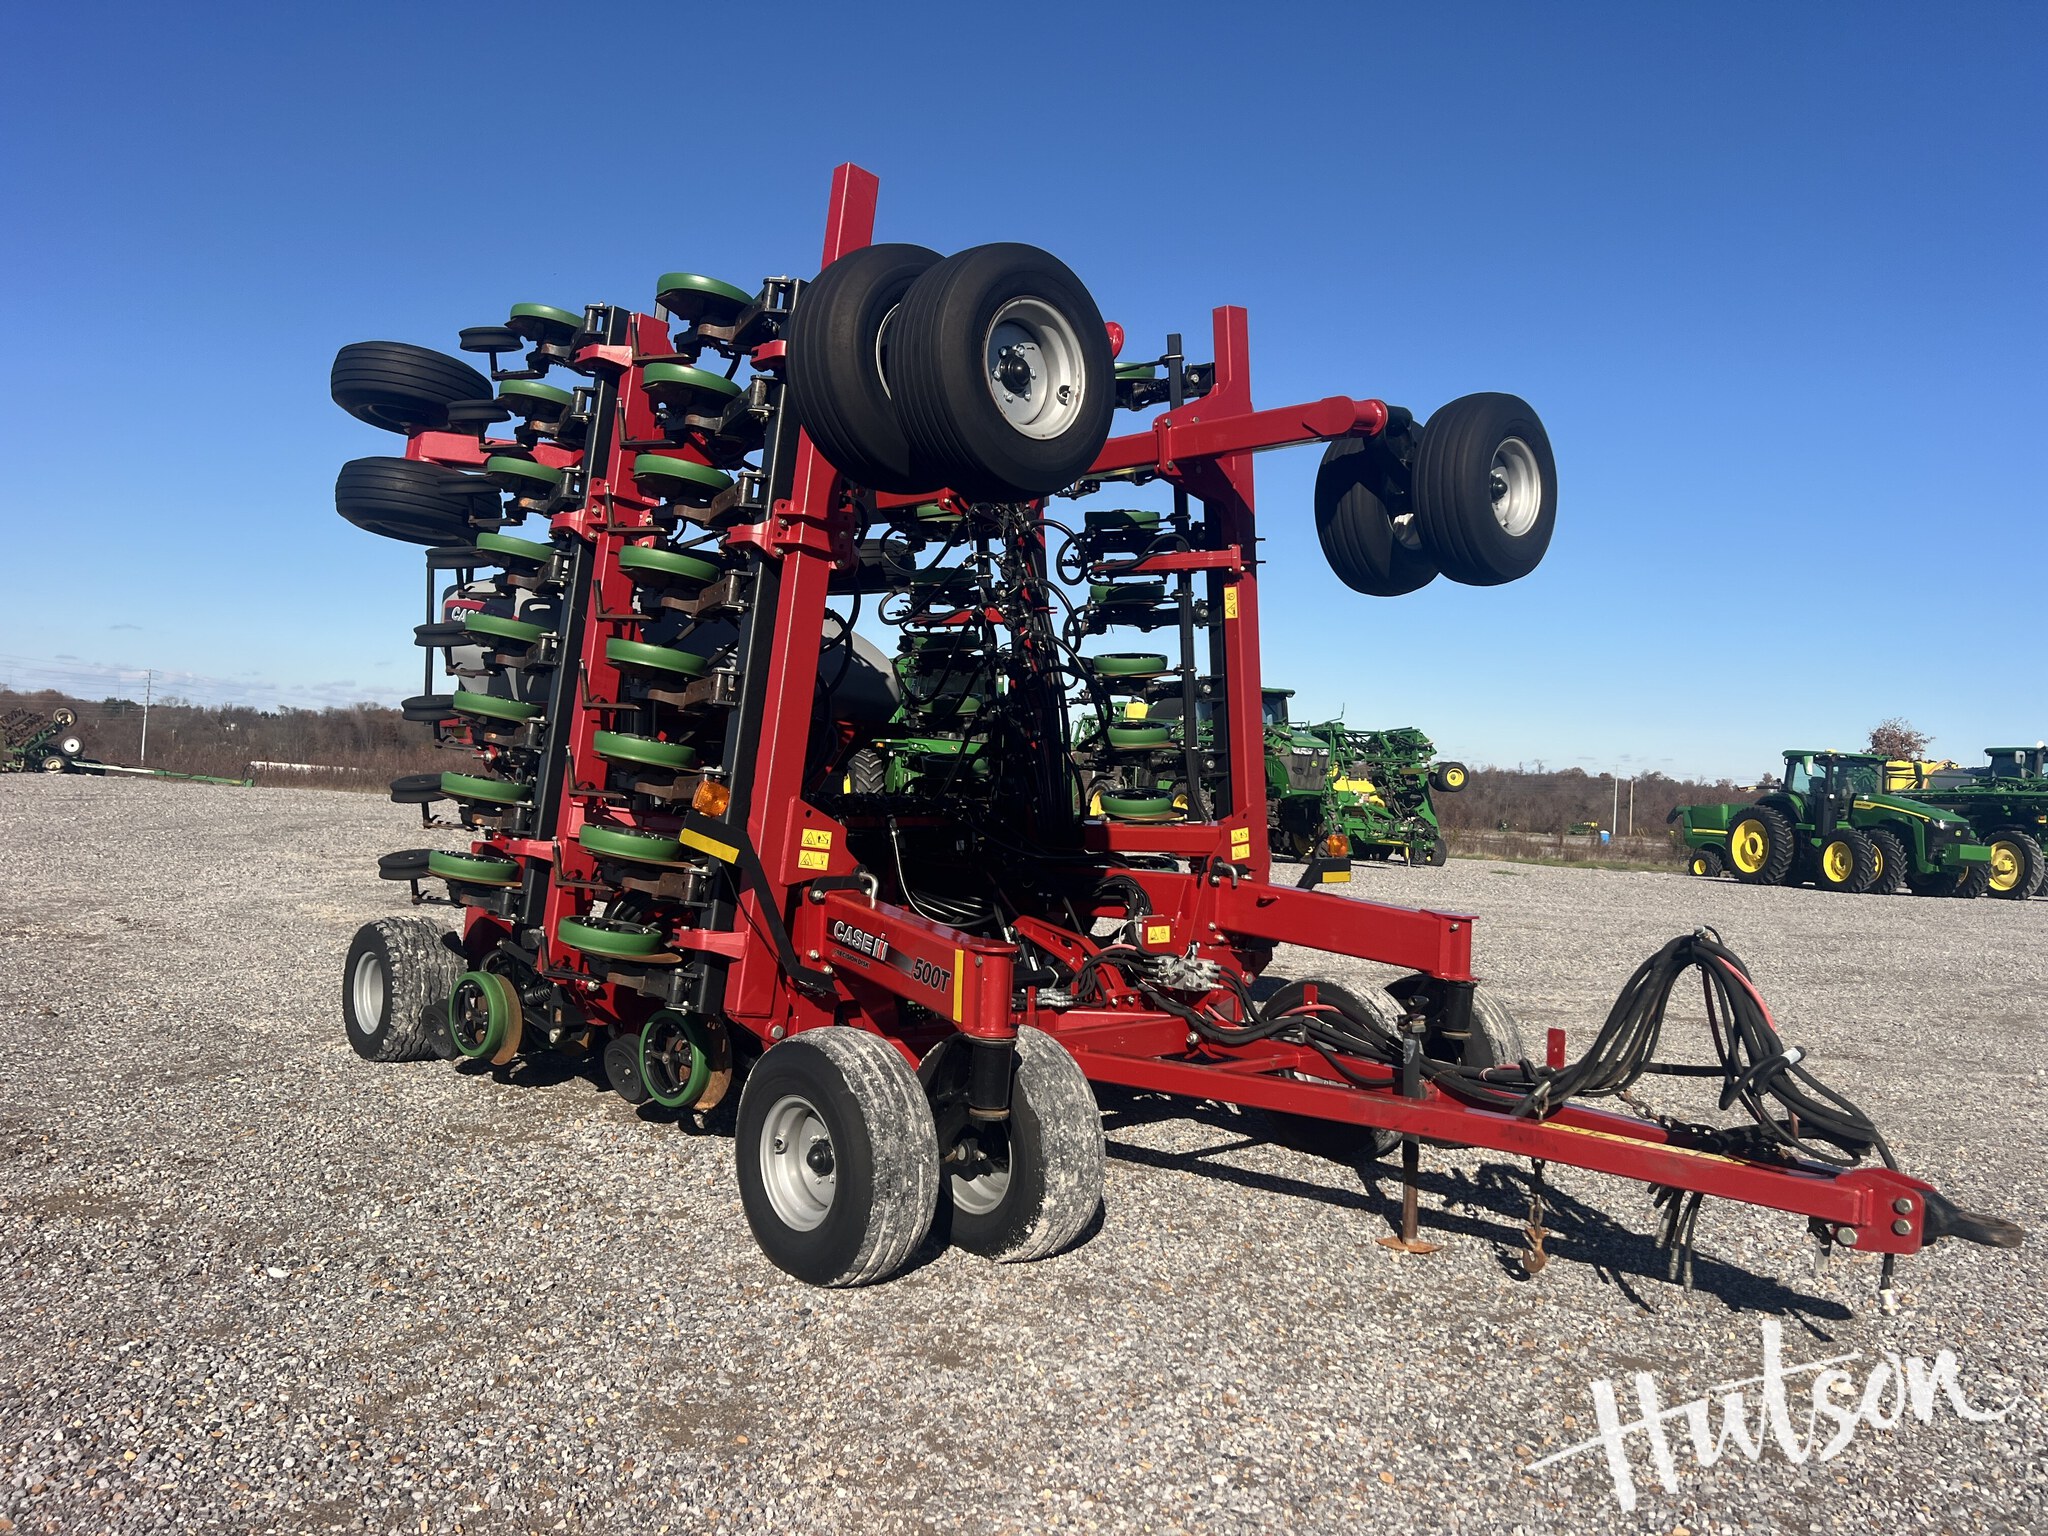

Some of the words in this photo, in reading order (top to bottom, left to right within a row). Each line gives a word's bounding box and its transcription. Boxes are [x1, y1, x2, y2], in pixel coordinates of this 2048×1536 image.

[452, 606, 480, 622] CA
[834, 921, 873, 953] CASE
[913, 958, 951, 993] 500T
